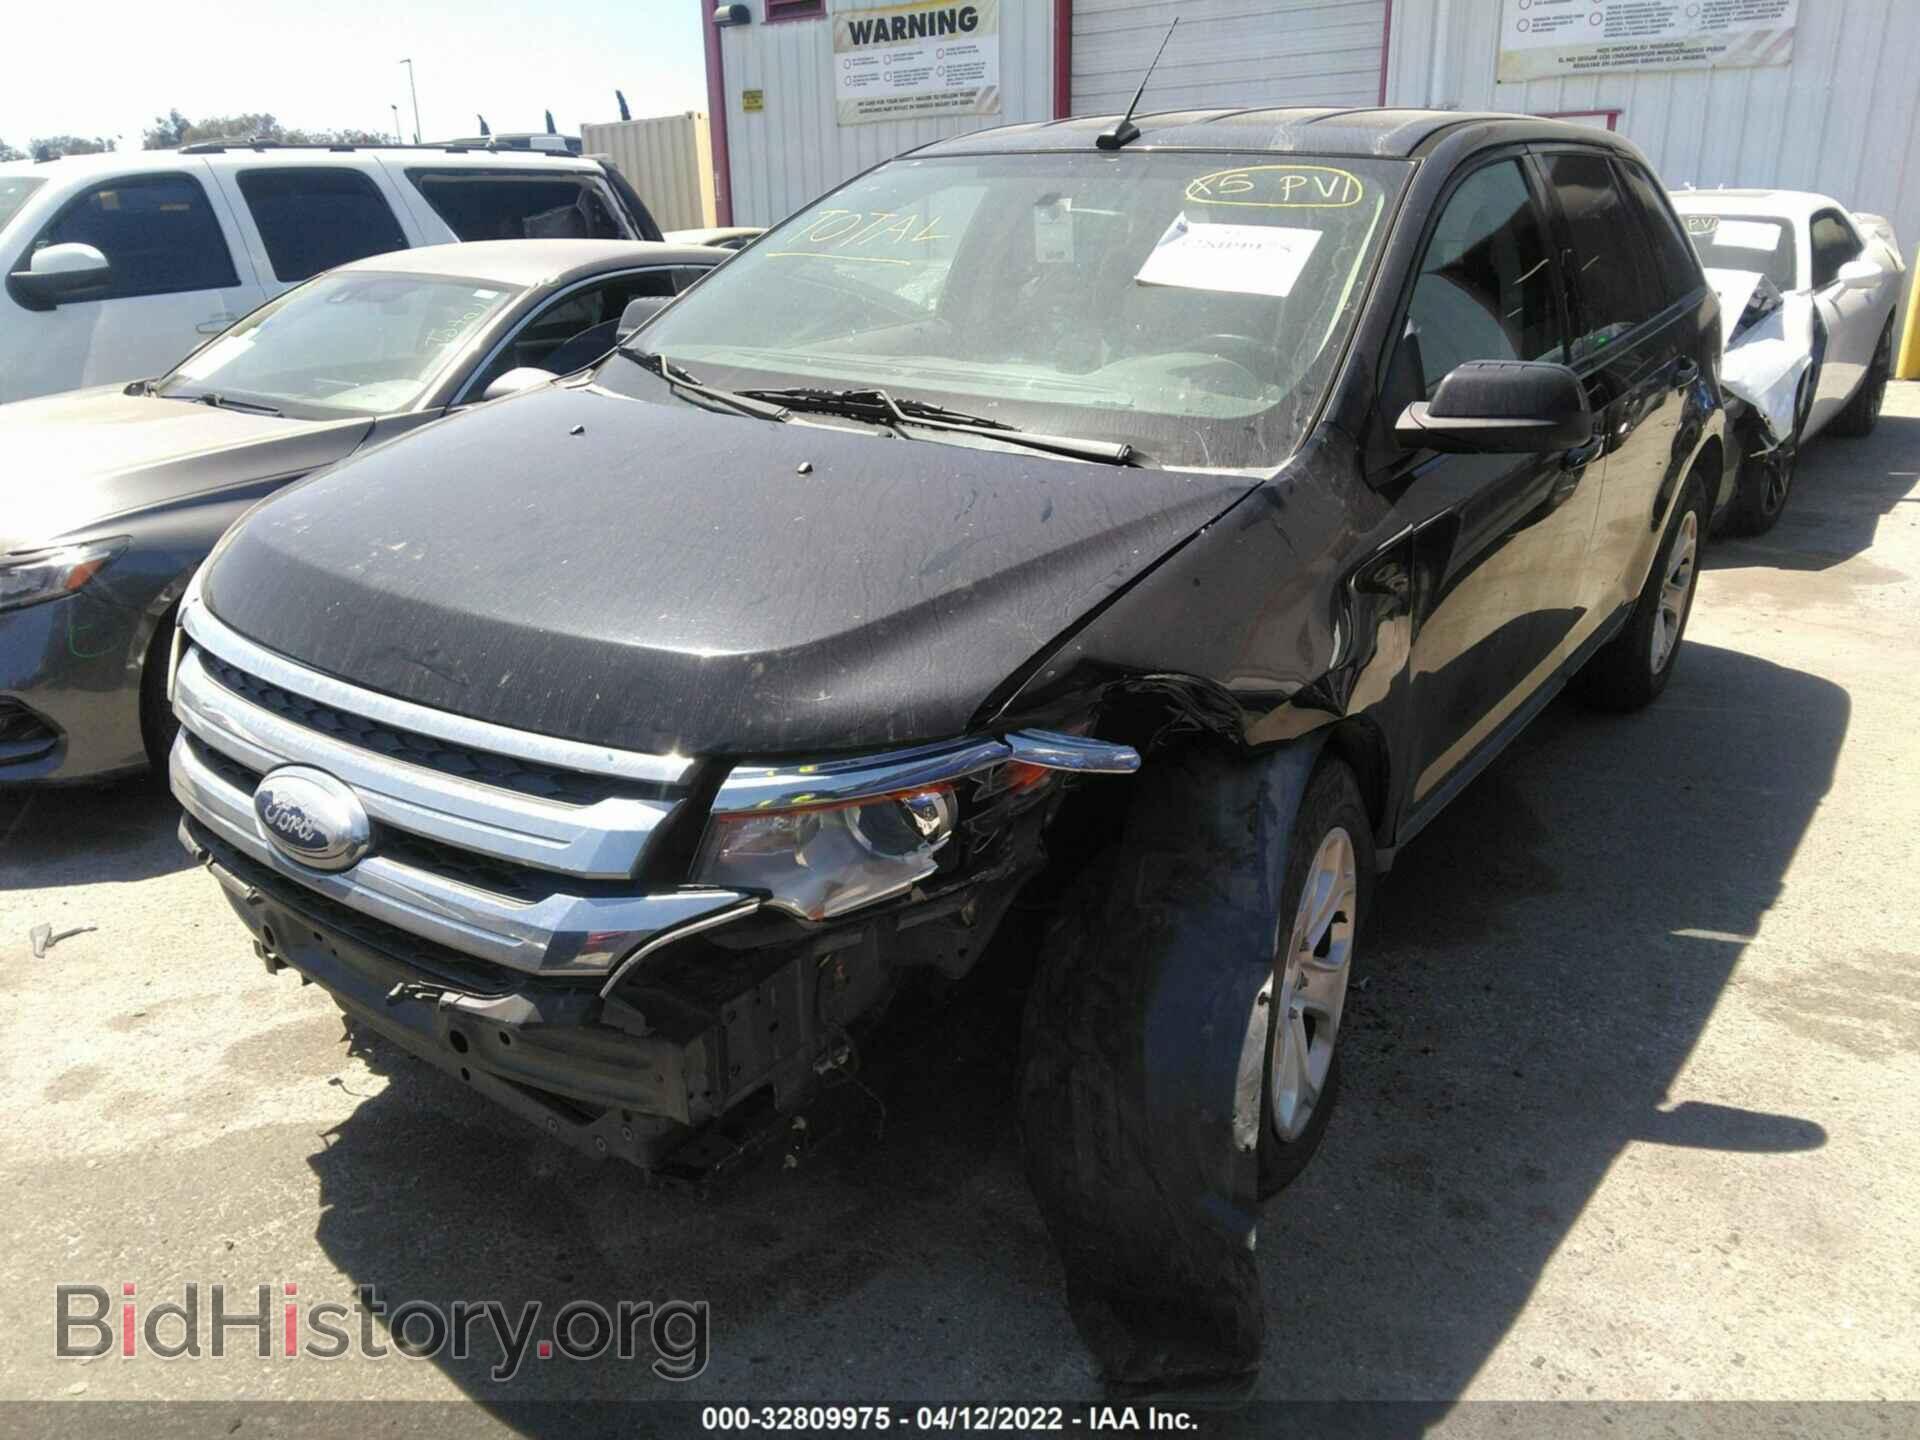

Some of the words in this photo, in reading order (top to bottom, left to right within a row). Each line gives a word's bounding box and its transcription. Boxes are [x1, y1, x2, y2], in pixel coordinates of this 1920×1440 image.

[849, 6, 978, 45] WARNING
[786, 209, 952, 248] TOTAL
[264, 801, 316, 841] Ford
